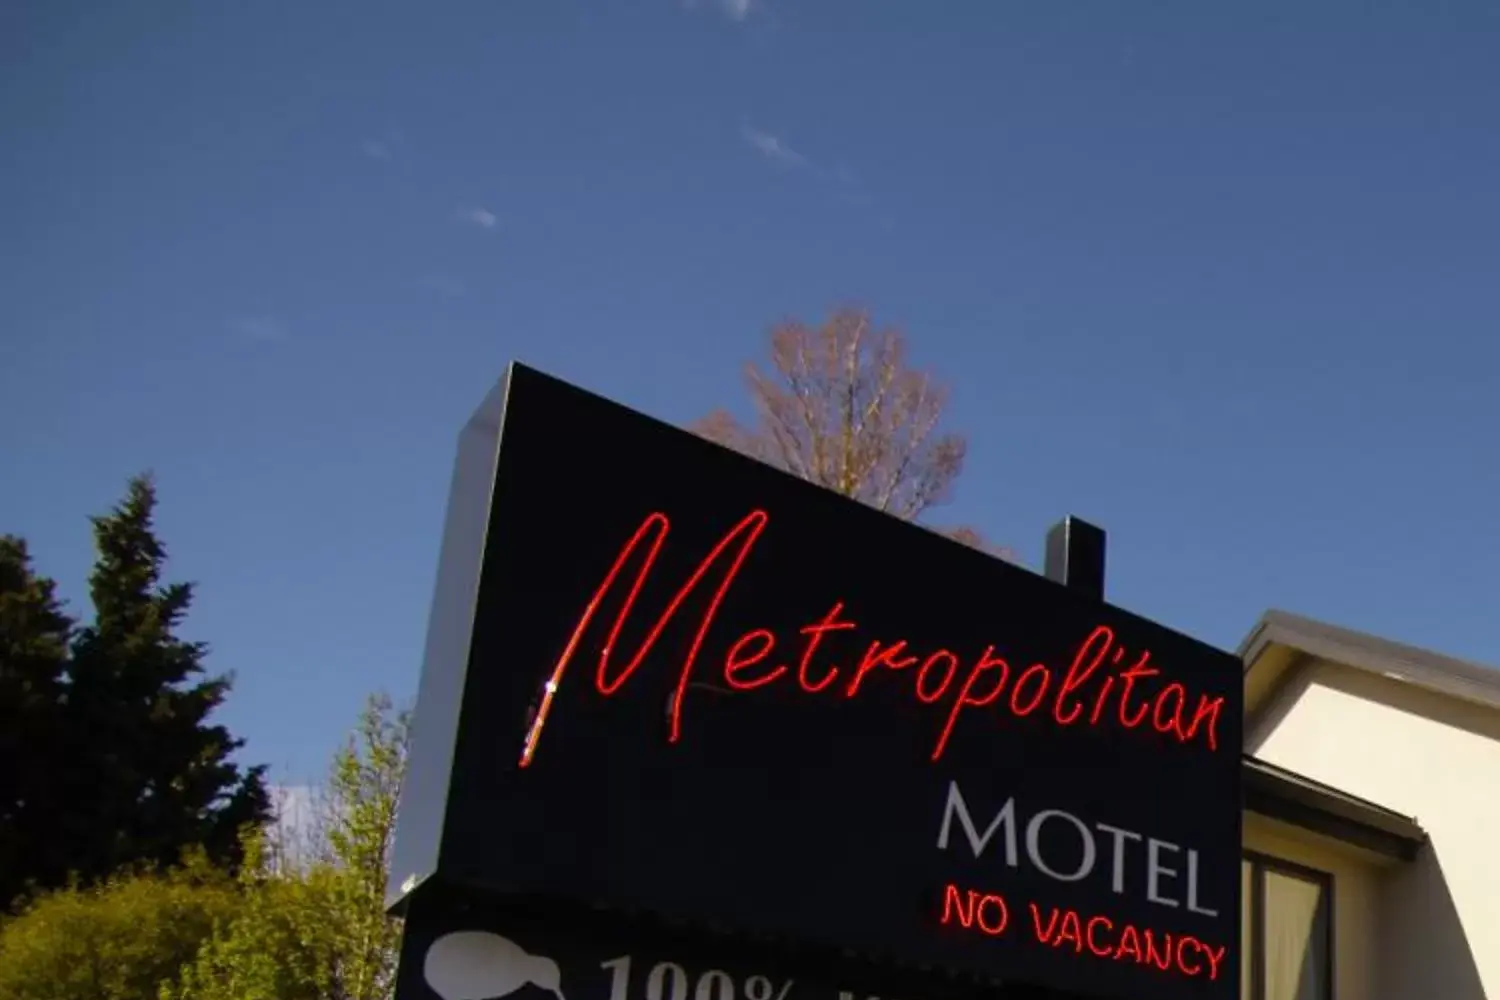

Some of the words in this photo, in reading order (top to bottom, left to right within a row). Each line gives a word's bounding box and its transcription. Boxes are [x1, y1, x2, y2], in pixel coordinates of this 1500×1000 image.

[519, 509, 1225, 768] Metropolitan
[937, 779, 1219, 917] MOTEL
[940, 883, 1009, 935] NO
[1028, 902, 1226, 981] VACANCY
